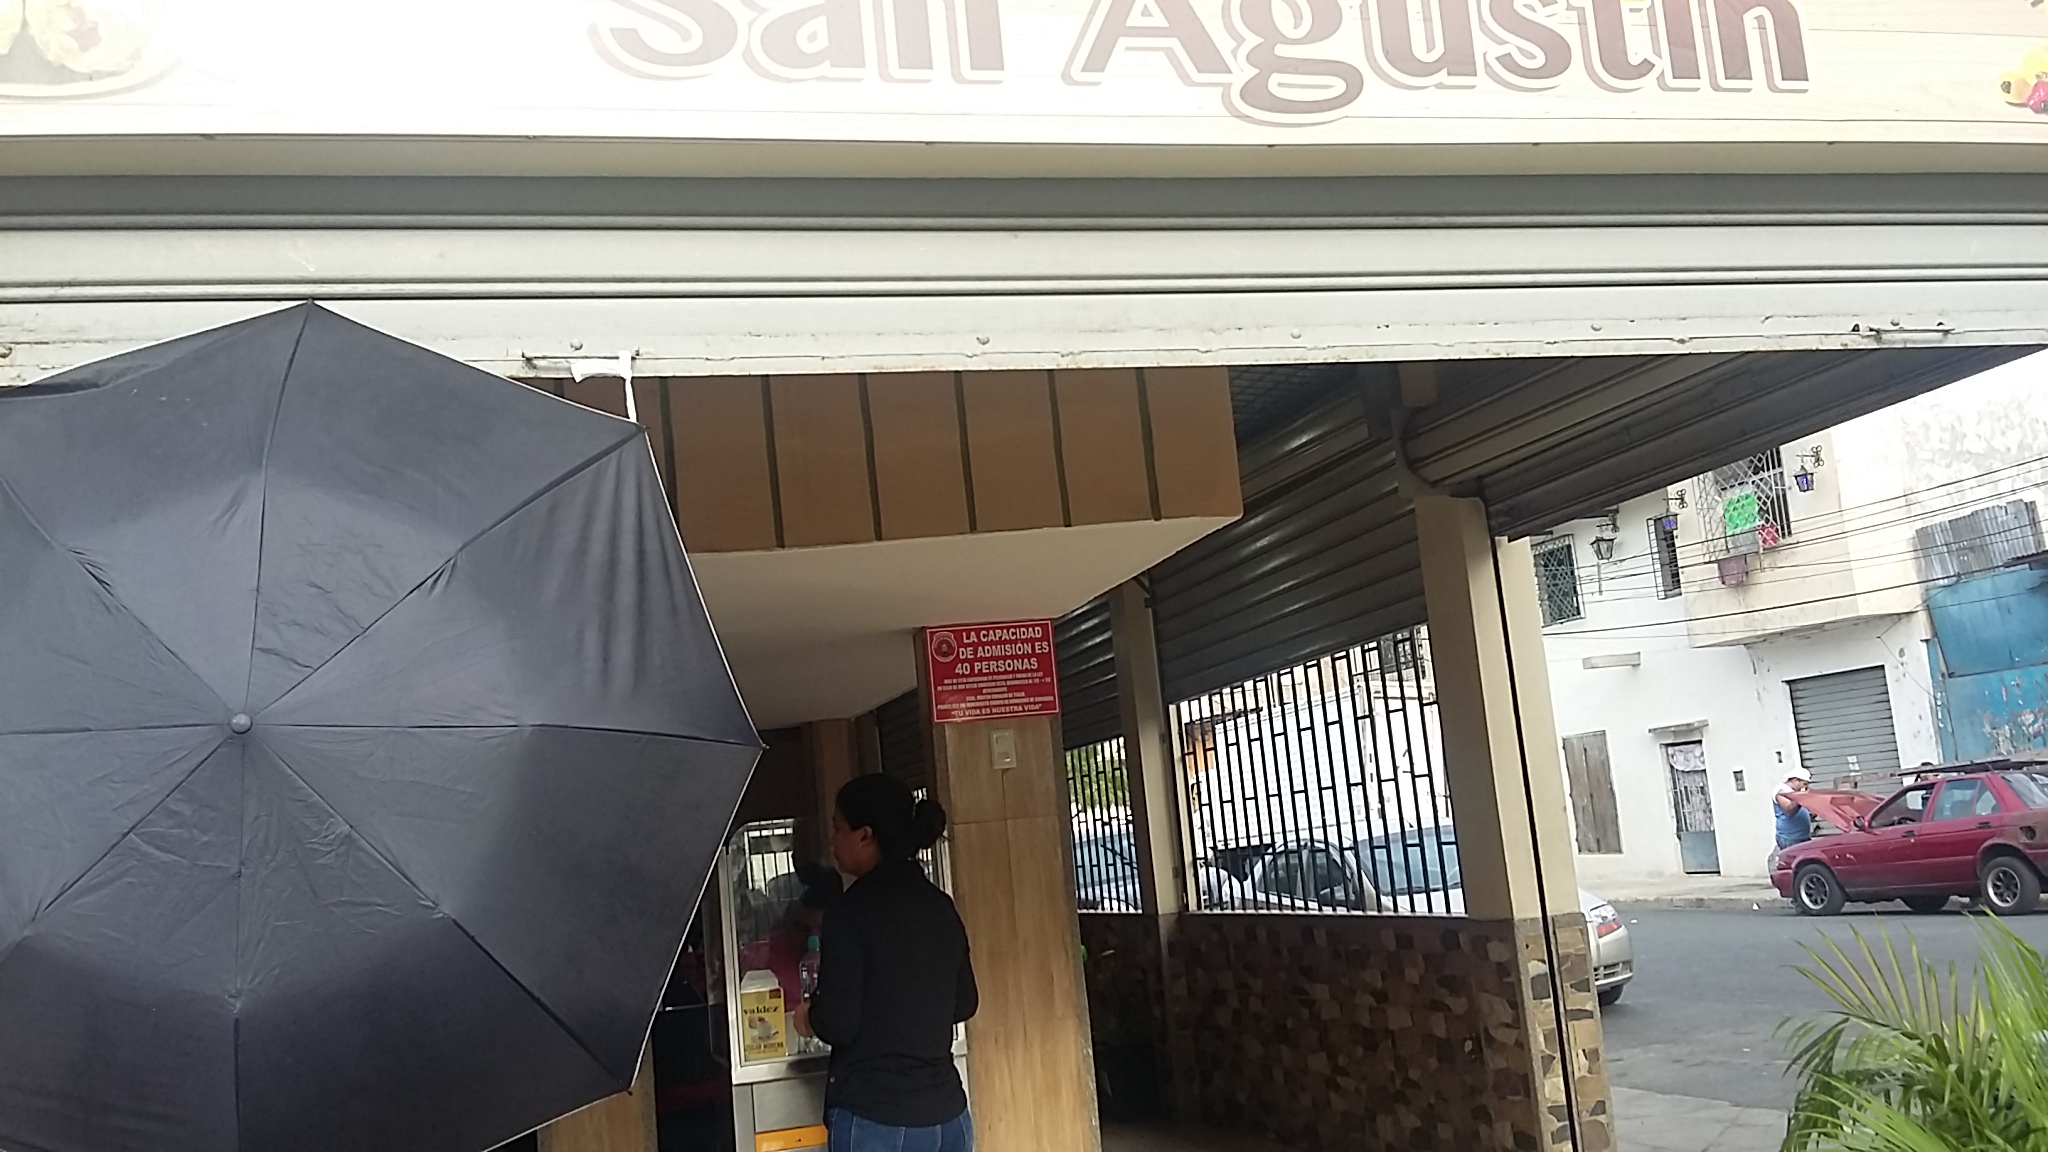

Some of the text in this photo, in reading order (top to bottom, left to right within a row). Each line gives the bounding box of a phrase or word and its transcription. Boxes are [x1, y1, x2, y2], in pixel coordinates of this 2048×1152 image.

[962, 626, 1043, 643] LA CAPACIDAD
[959, 647, 975, 659] DE
[977, 640, 1032, 658] ADMISIÓN
[1034, 641, 1049, 654] ES
[955, 657, 1038, 675] 40 PERSONAS
[992, 705, 1023, 714] NUESTRA
[743, 1005, 779, 1015] valdez
